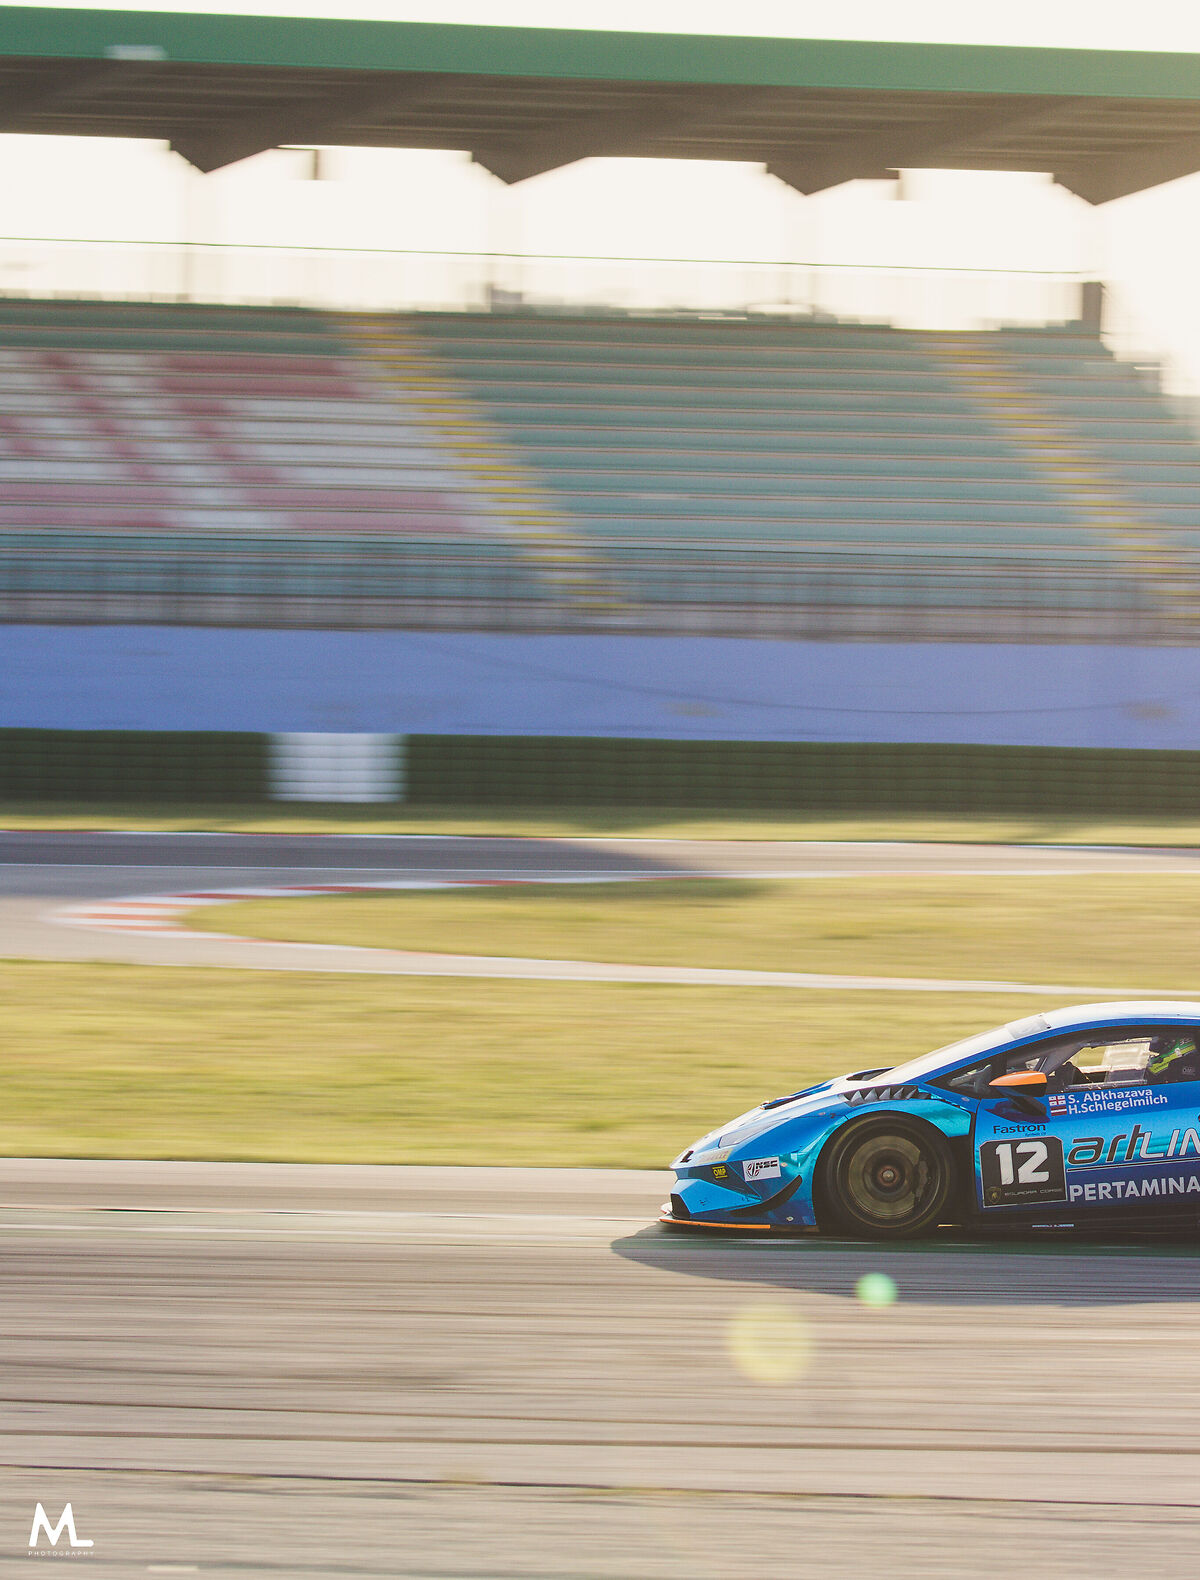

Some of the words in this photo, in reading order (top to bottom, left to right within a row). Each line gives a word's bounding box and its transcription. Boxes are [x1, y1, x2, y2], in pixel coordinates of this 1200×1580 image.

[1068, 1094, 1080, 1104] S.
[1083, 1088, 1153, 1103] Abkhazava
[1068, 1094, 1168, 1115] H.Schlegelmilch
[993, 1124, 1046, 1134] Fastron
[713, 1167, 727, 1176] OMP
[995, 1141, 1049, 1186] 12
